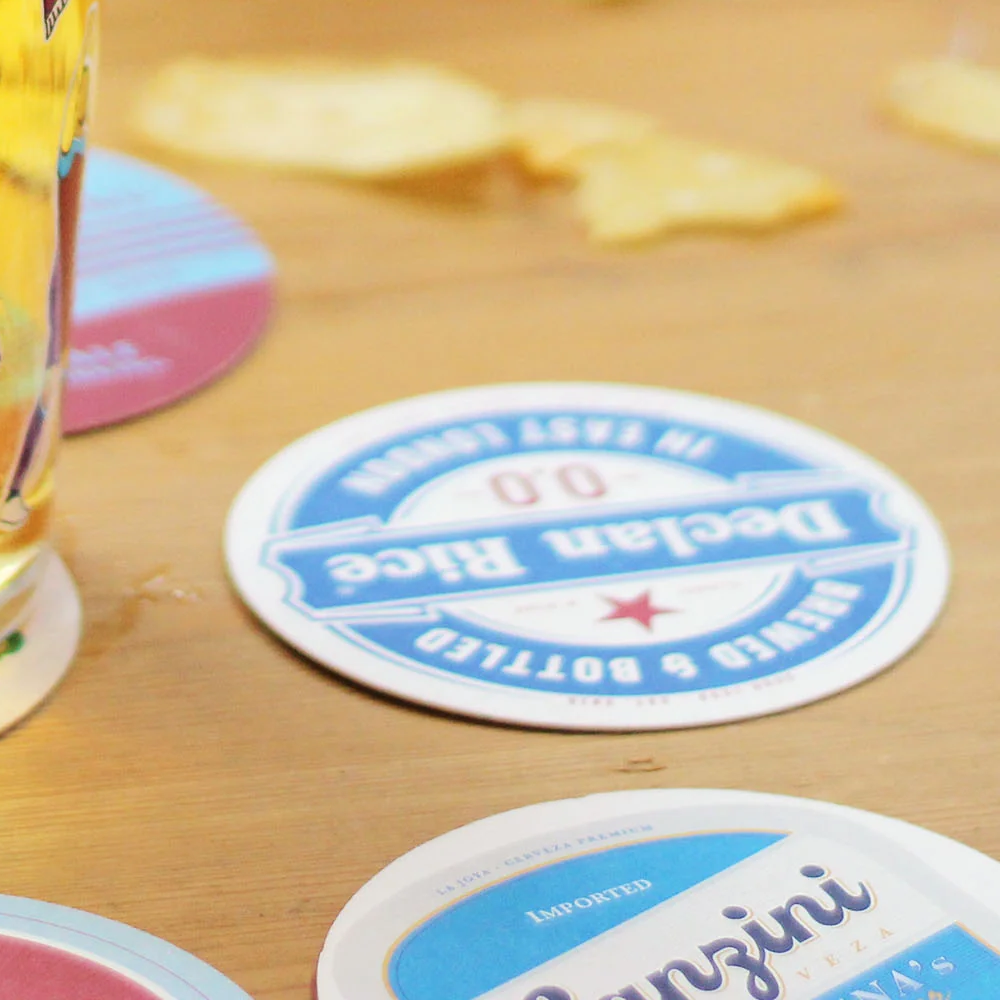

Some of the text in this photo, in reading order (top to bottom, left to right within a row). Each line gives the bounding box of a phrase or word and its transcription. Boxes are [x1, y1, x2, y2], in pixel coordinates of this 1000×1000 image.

[518, 416, 645, 446] EAST
[653, 426, 714, 460] IN
[325, 499, 850, 584] Declan Rice
[414, 578, 863, 684] BREWED & BOTTLED
[524, 877, 654, 924] IMPORTED
